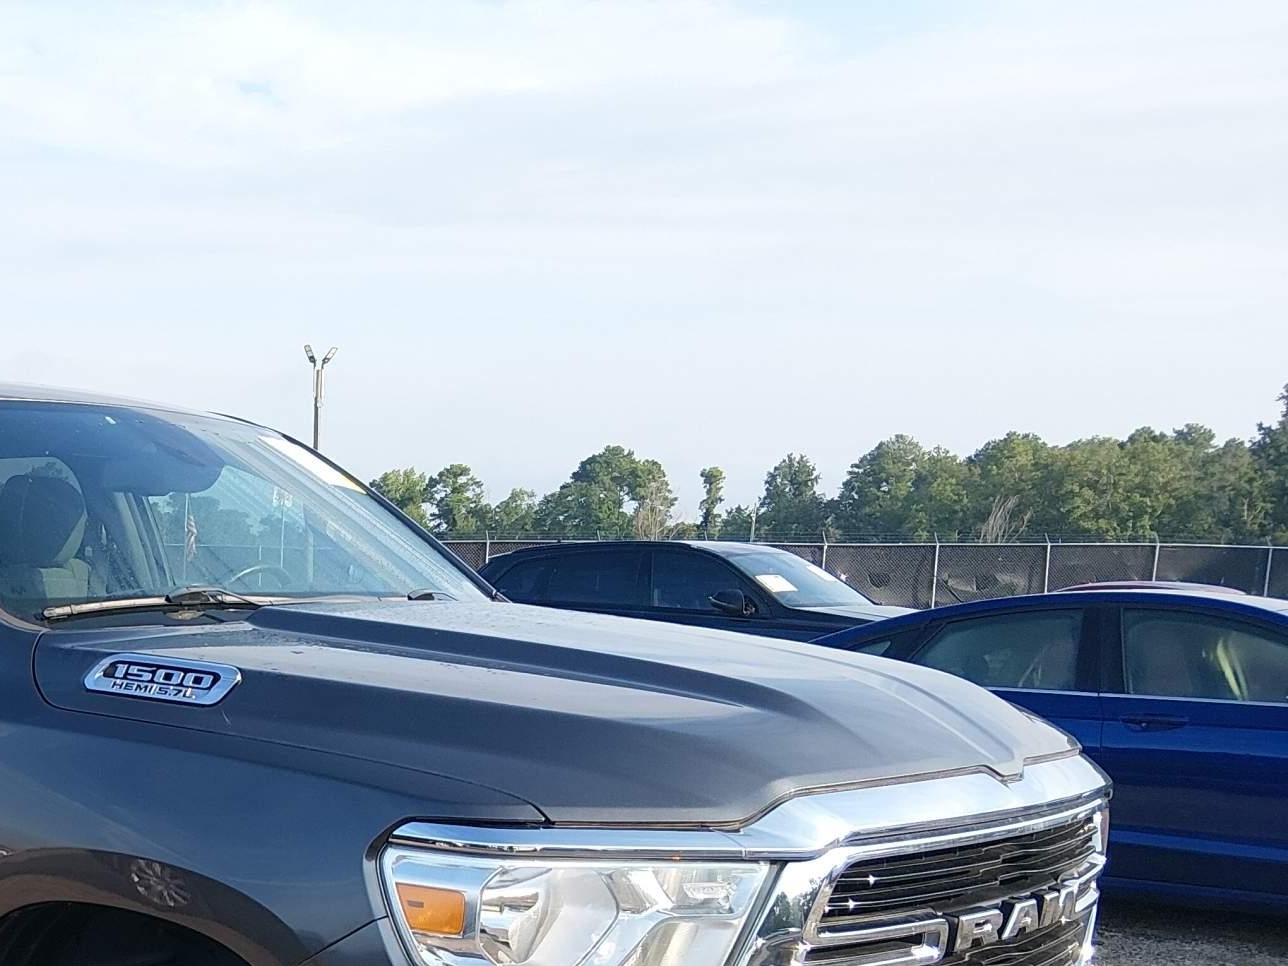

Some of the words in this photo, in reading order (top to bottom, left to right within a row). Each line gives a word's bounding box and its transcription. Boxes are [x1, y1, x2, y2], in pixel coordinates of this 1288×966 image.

[111, 680, 153, 694] HEMI
[114, 663, 214, 689] 1500
[954, 885, 1076, 951] RAM
